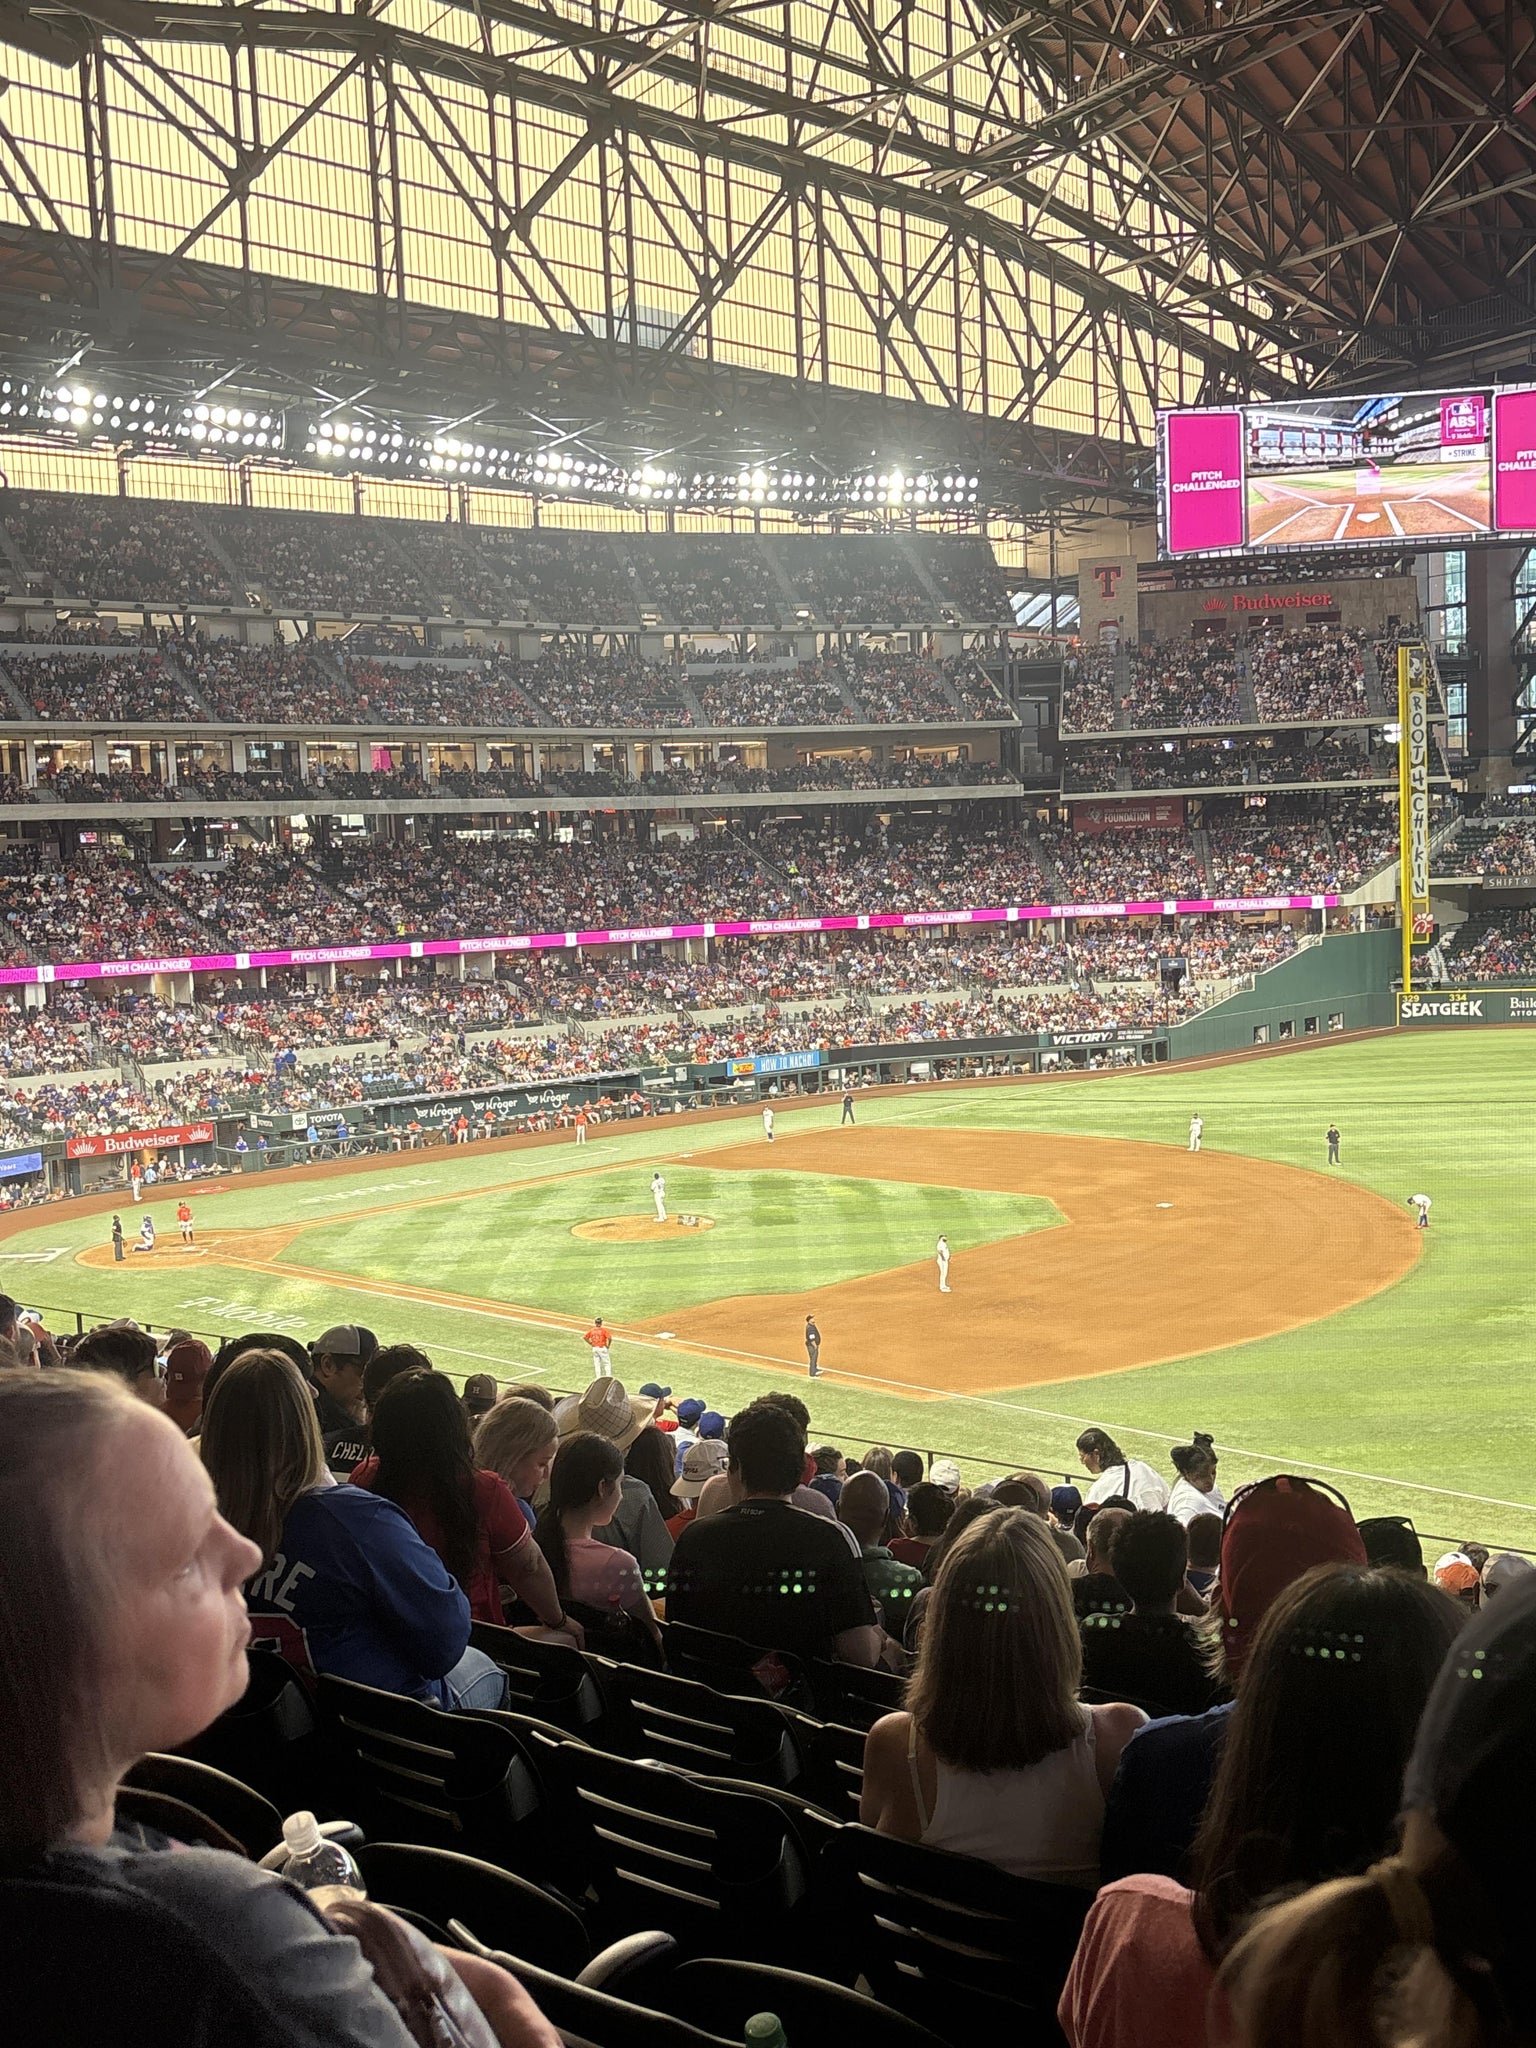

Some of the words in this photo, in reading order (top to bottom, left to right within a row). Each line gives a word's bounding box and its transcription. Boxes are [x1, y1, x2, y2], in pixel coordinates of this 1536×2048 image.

[1450, 416, 1476, 428] ABS
[1453, 448, 1477, 457] STRIKE
[1191, 470, 1223, 481] PITCH
[1172, 479, 1241, 493] CHALLENGED
[1093, 565, 1122, 600] T
[1104, 812, 1151, 823] FOUNDATION
[1412, 797, 1426, 894] CHIKIN
[1489, 878, 1521, 887] SHIFT
[1050, 906, 1075, 915] PITCH
[1214, 900, 1238, 910] PITCH
[903, 915, 926, 924] PITCH
[750, 922, 774, 931] PITCH
[608, 931, 630, 940] PITCH
[459, 940, 483, 950] PITCH
[291, 951, 317, 962] PITCH
[100, 964, 130, 974] PITCH
[1402, 995, 1420, 1003] 329
[1449, 993, 1468, 1002] 334
[1401, 1000, 1483, 1019] SEATGEEK
[1053, 1032, 1109, 1045] VICTORY
[761, 1058, 777, 1071] HOW
[780, 1057, 788, 1070] TO
[539, 1089, 570, 1108] Kroger
[486, 1096, 518, 1114] Kroger
[430, 1103, 463, 1121] Kroger
[309, 1113, 345, 1124] TOYOTA
[104, 1133, 181, 1153] Budweiser
